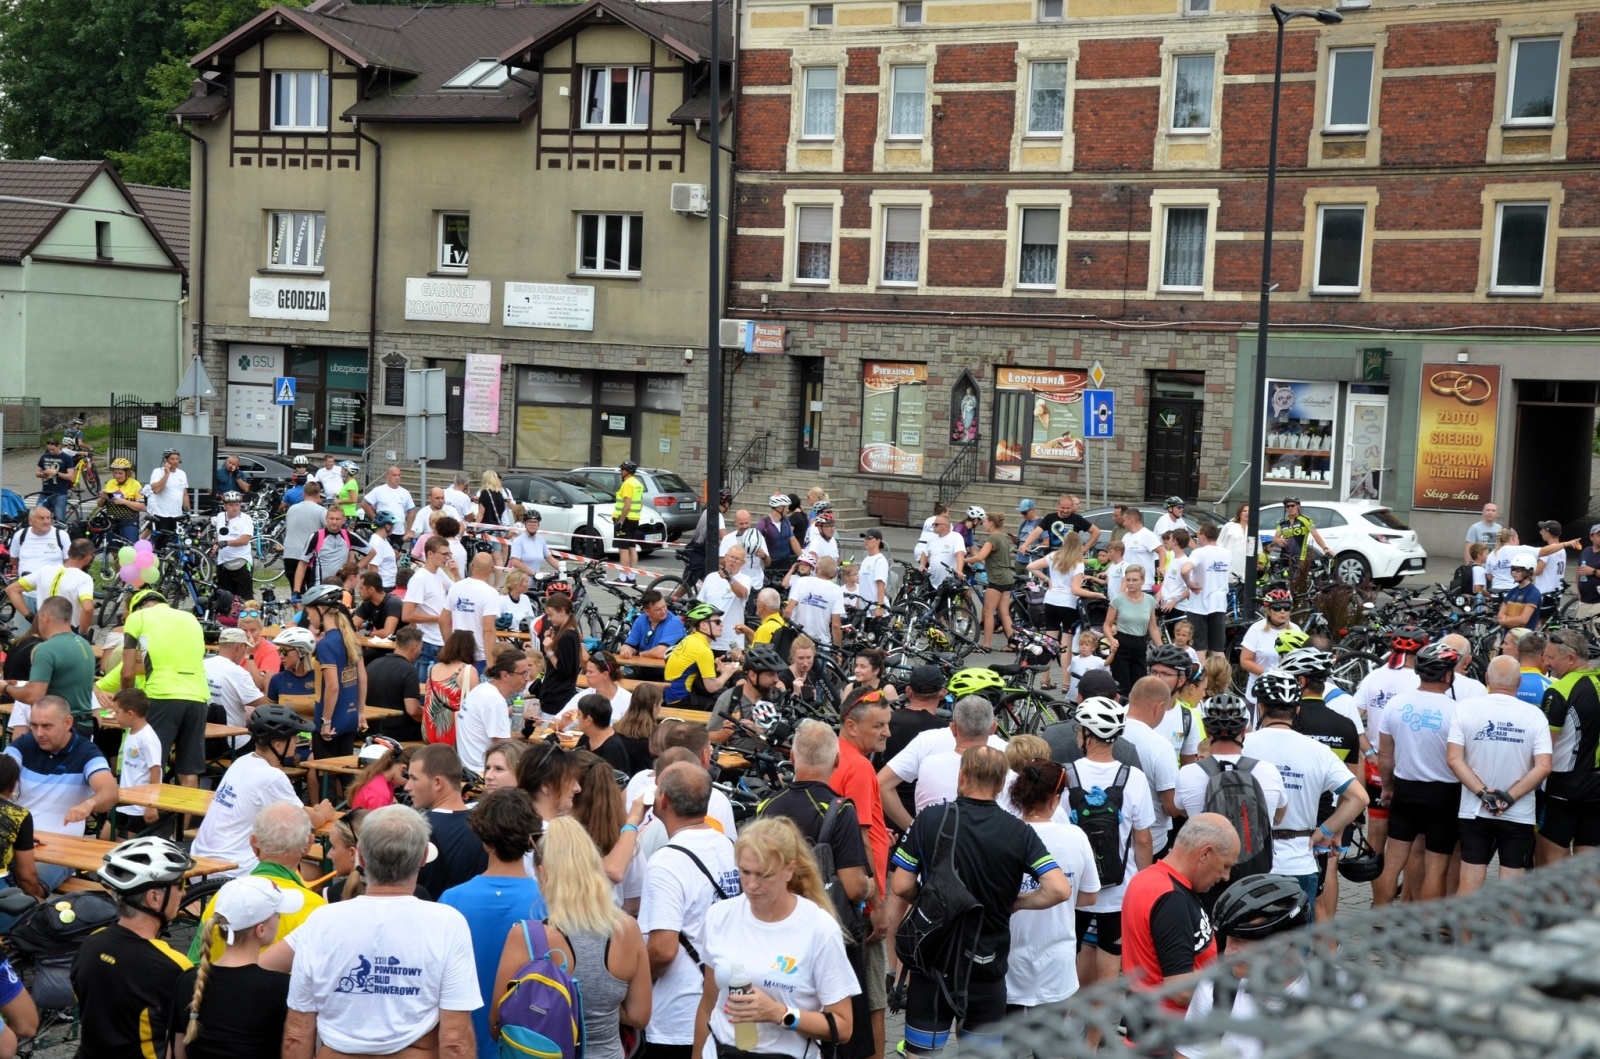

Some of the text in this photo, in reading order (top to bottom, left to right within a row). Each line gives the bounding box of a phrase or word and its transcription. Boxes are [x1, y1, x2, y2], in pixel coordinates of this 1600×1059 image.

[272, 216, 288, 262] SOLARIUM
[293, 216, 309, 263] KOSMETYKA
[421, 283, 475, 298] GABINET
[278, 289, 326, 310] GEODEZJA
[408, 301, 489, 317] KOSMETYCZNY
[252, 355, 275, 368] GSU
[872, 365, 915, 376] PIEKARNIA
[1437, 411, 1478, 425] ZŁOTO
[1431, 431, 1482, 446] SREBRO
[1034, 446, 1079, 457] CUKIERNIA
[1423, 452, 1487, 467] NAPRAWA
[1429, 466, 1479, 480] biżuterii
[1423, 488, 1480, 501] Skup złota
[374, 966, 422, 977] POWIATOWY
